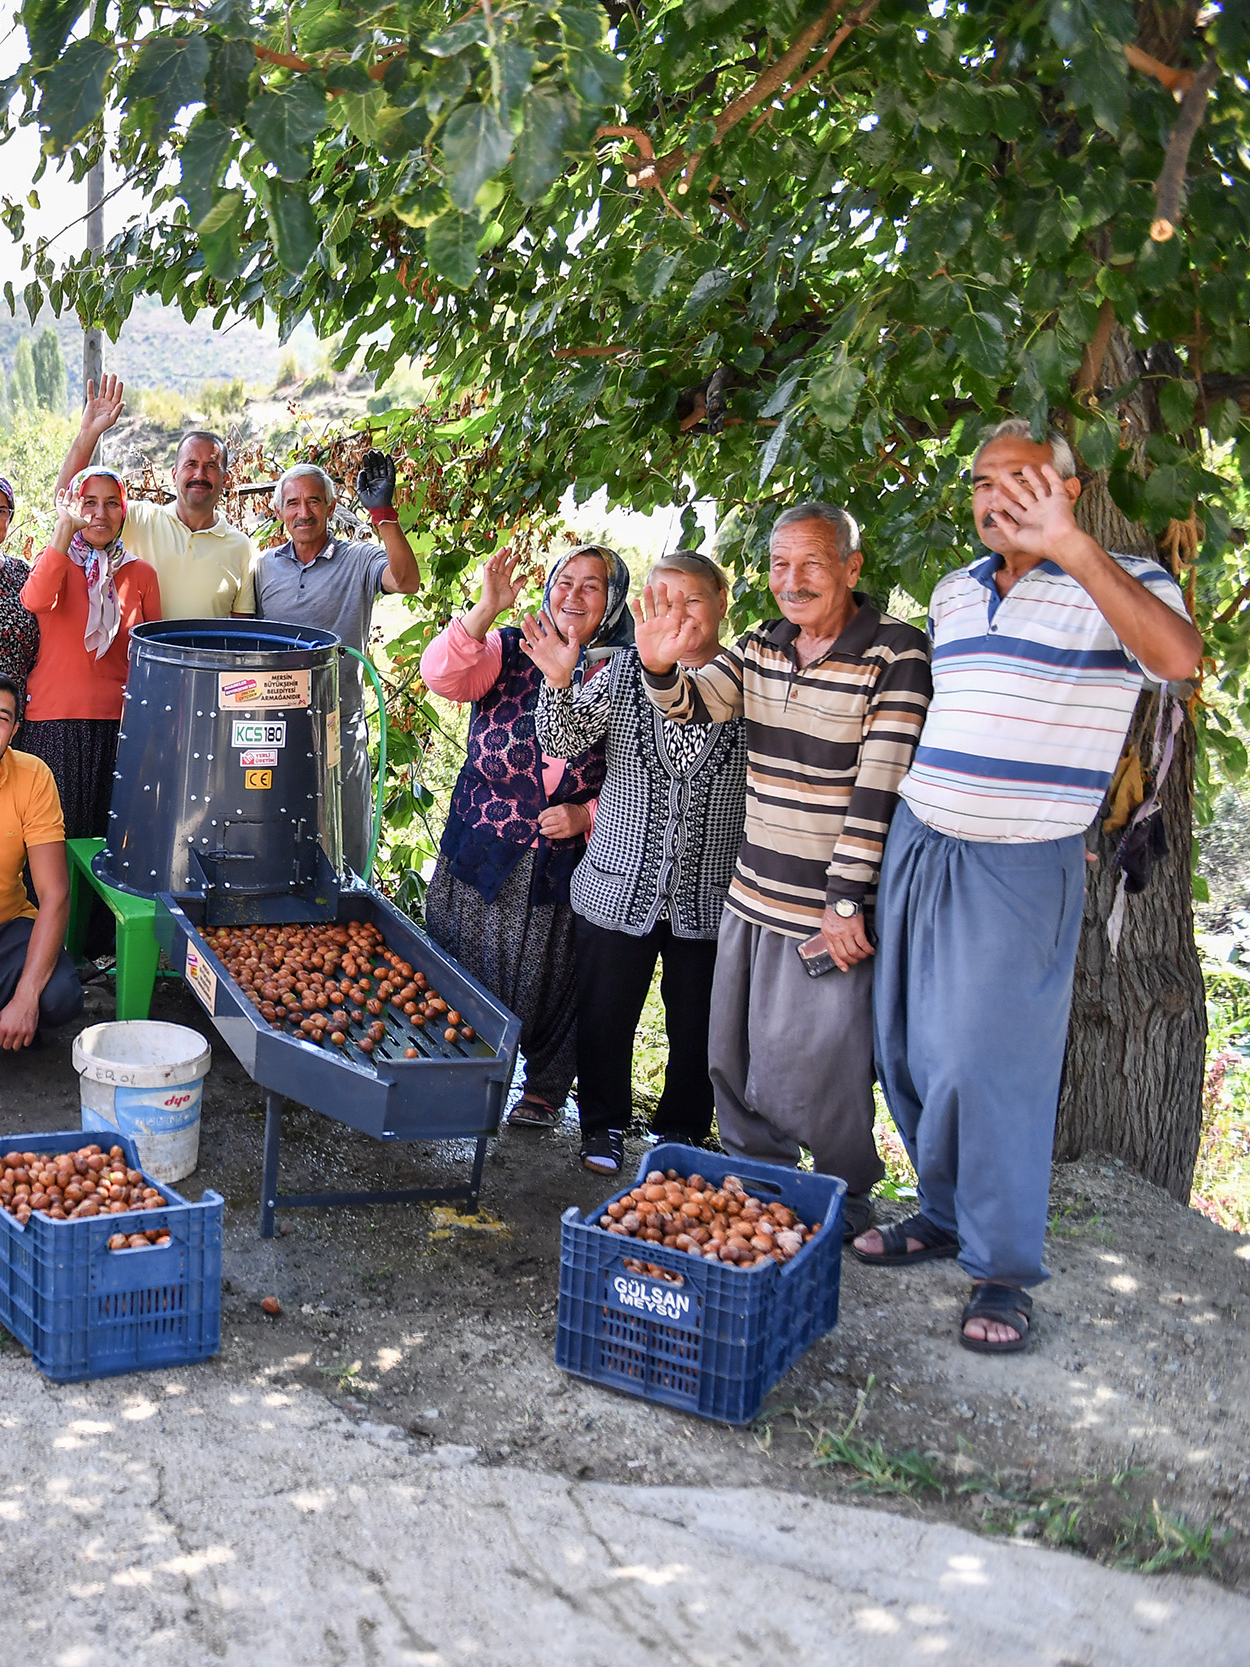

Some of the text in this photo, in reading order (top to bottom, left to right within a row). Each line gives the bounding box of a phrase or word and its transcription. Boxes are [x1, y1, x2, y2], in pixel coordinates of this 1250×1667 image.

[271, 673, 293, 681] MERSİN
[263, 680, 299, 688] BÜYÜKŞEHİR
[267, 687, 296, 695] BELEDİYESİ
[260, 693, 301, 701] ARMAĞANIDIR
[249, 772, 268, 787] CE
[164, 1094, 190, 1108] dyo
[613, 1276, 690, 1312] GÜLSAN
[619, 1292, 681, 1319] MEYSU
